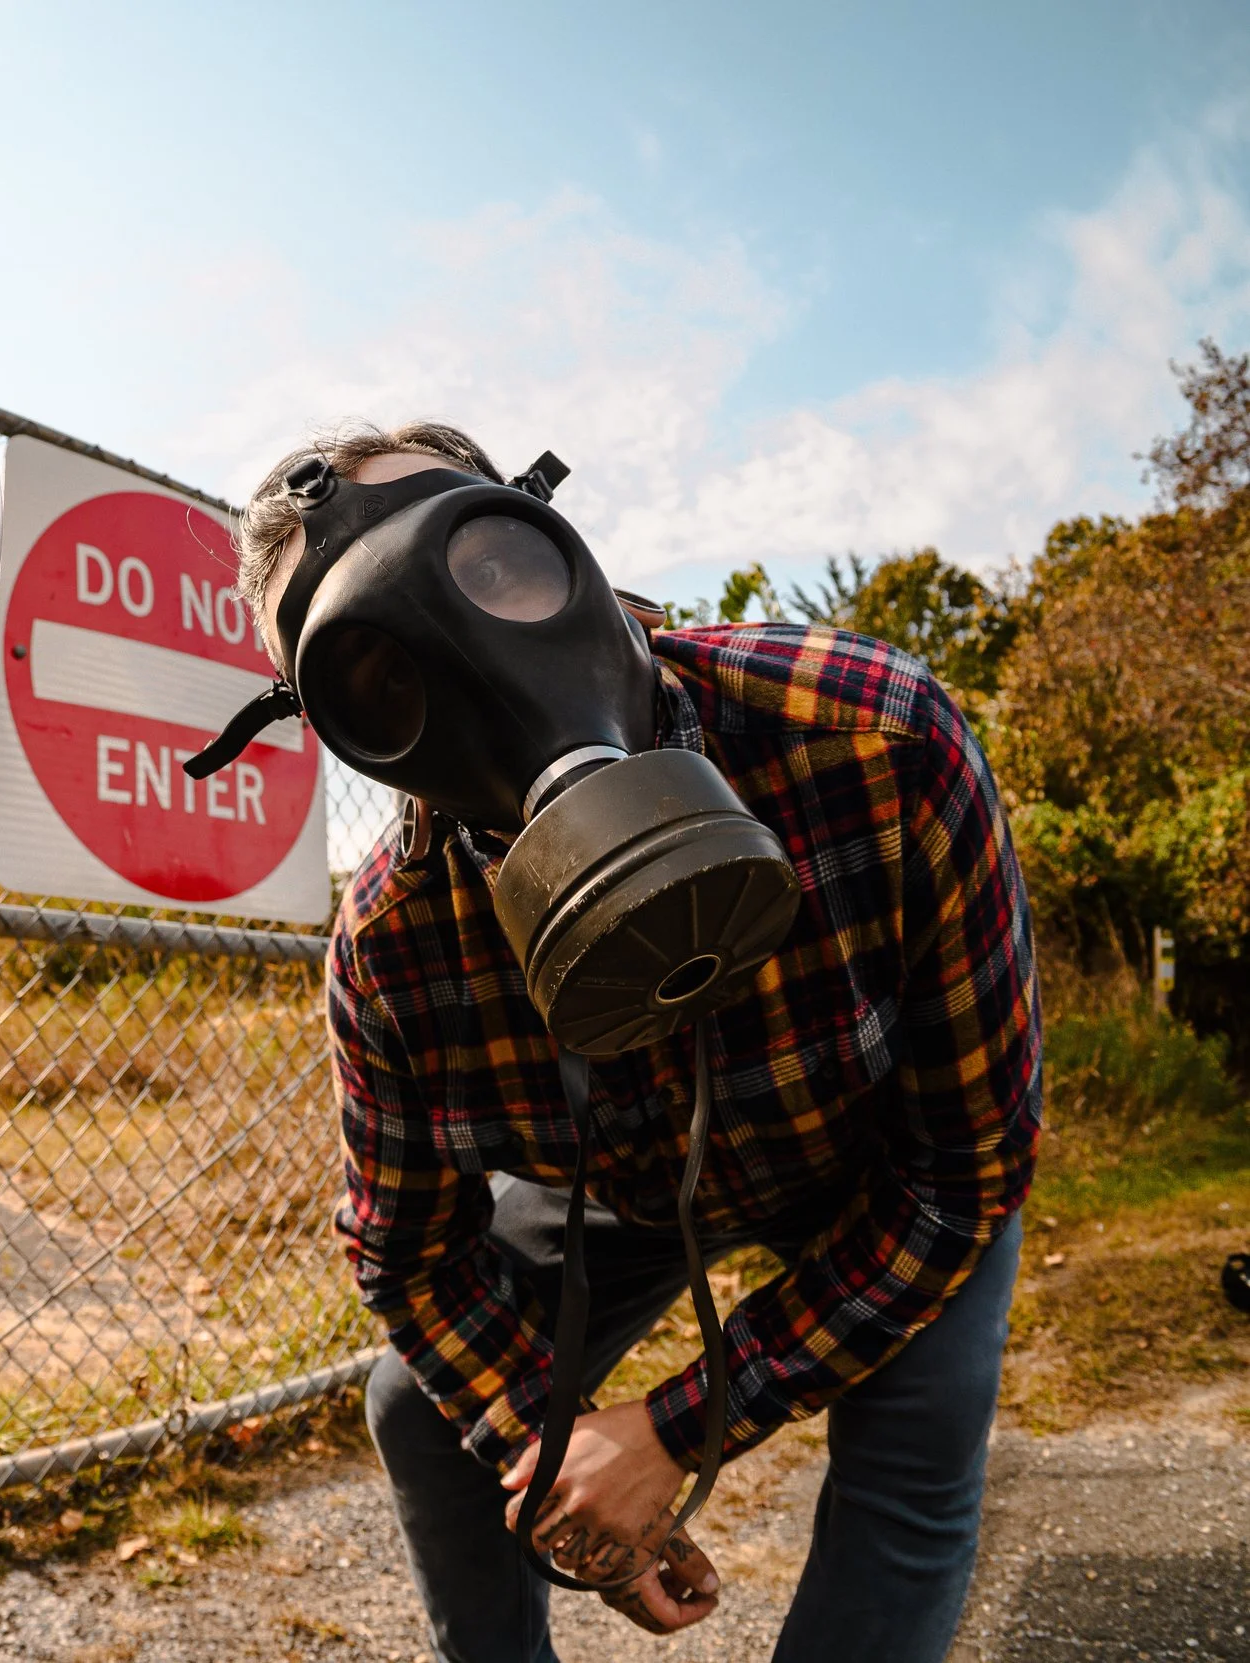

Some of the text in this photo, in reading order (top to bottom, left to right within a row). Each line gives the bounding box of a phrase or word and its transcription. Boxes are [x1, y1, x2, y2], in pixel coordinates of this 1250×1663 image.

[75, 542, 265, 652] DO NO
[96, 734, 267, 825] ENTER
